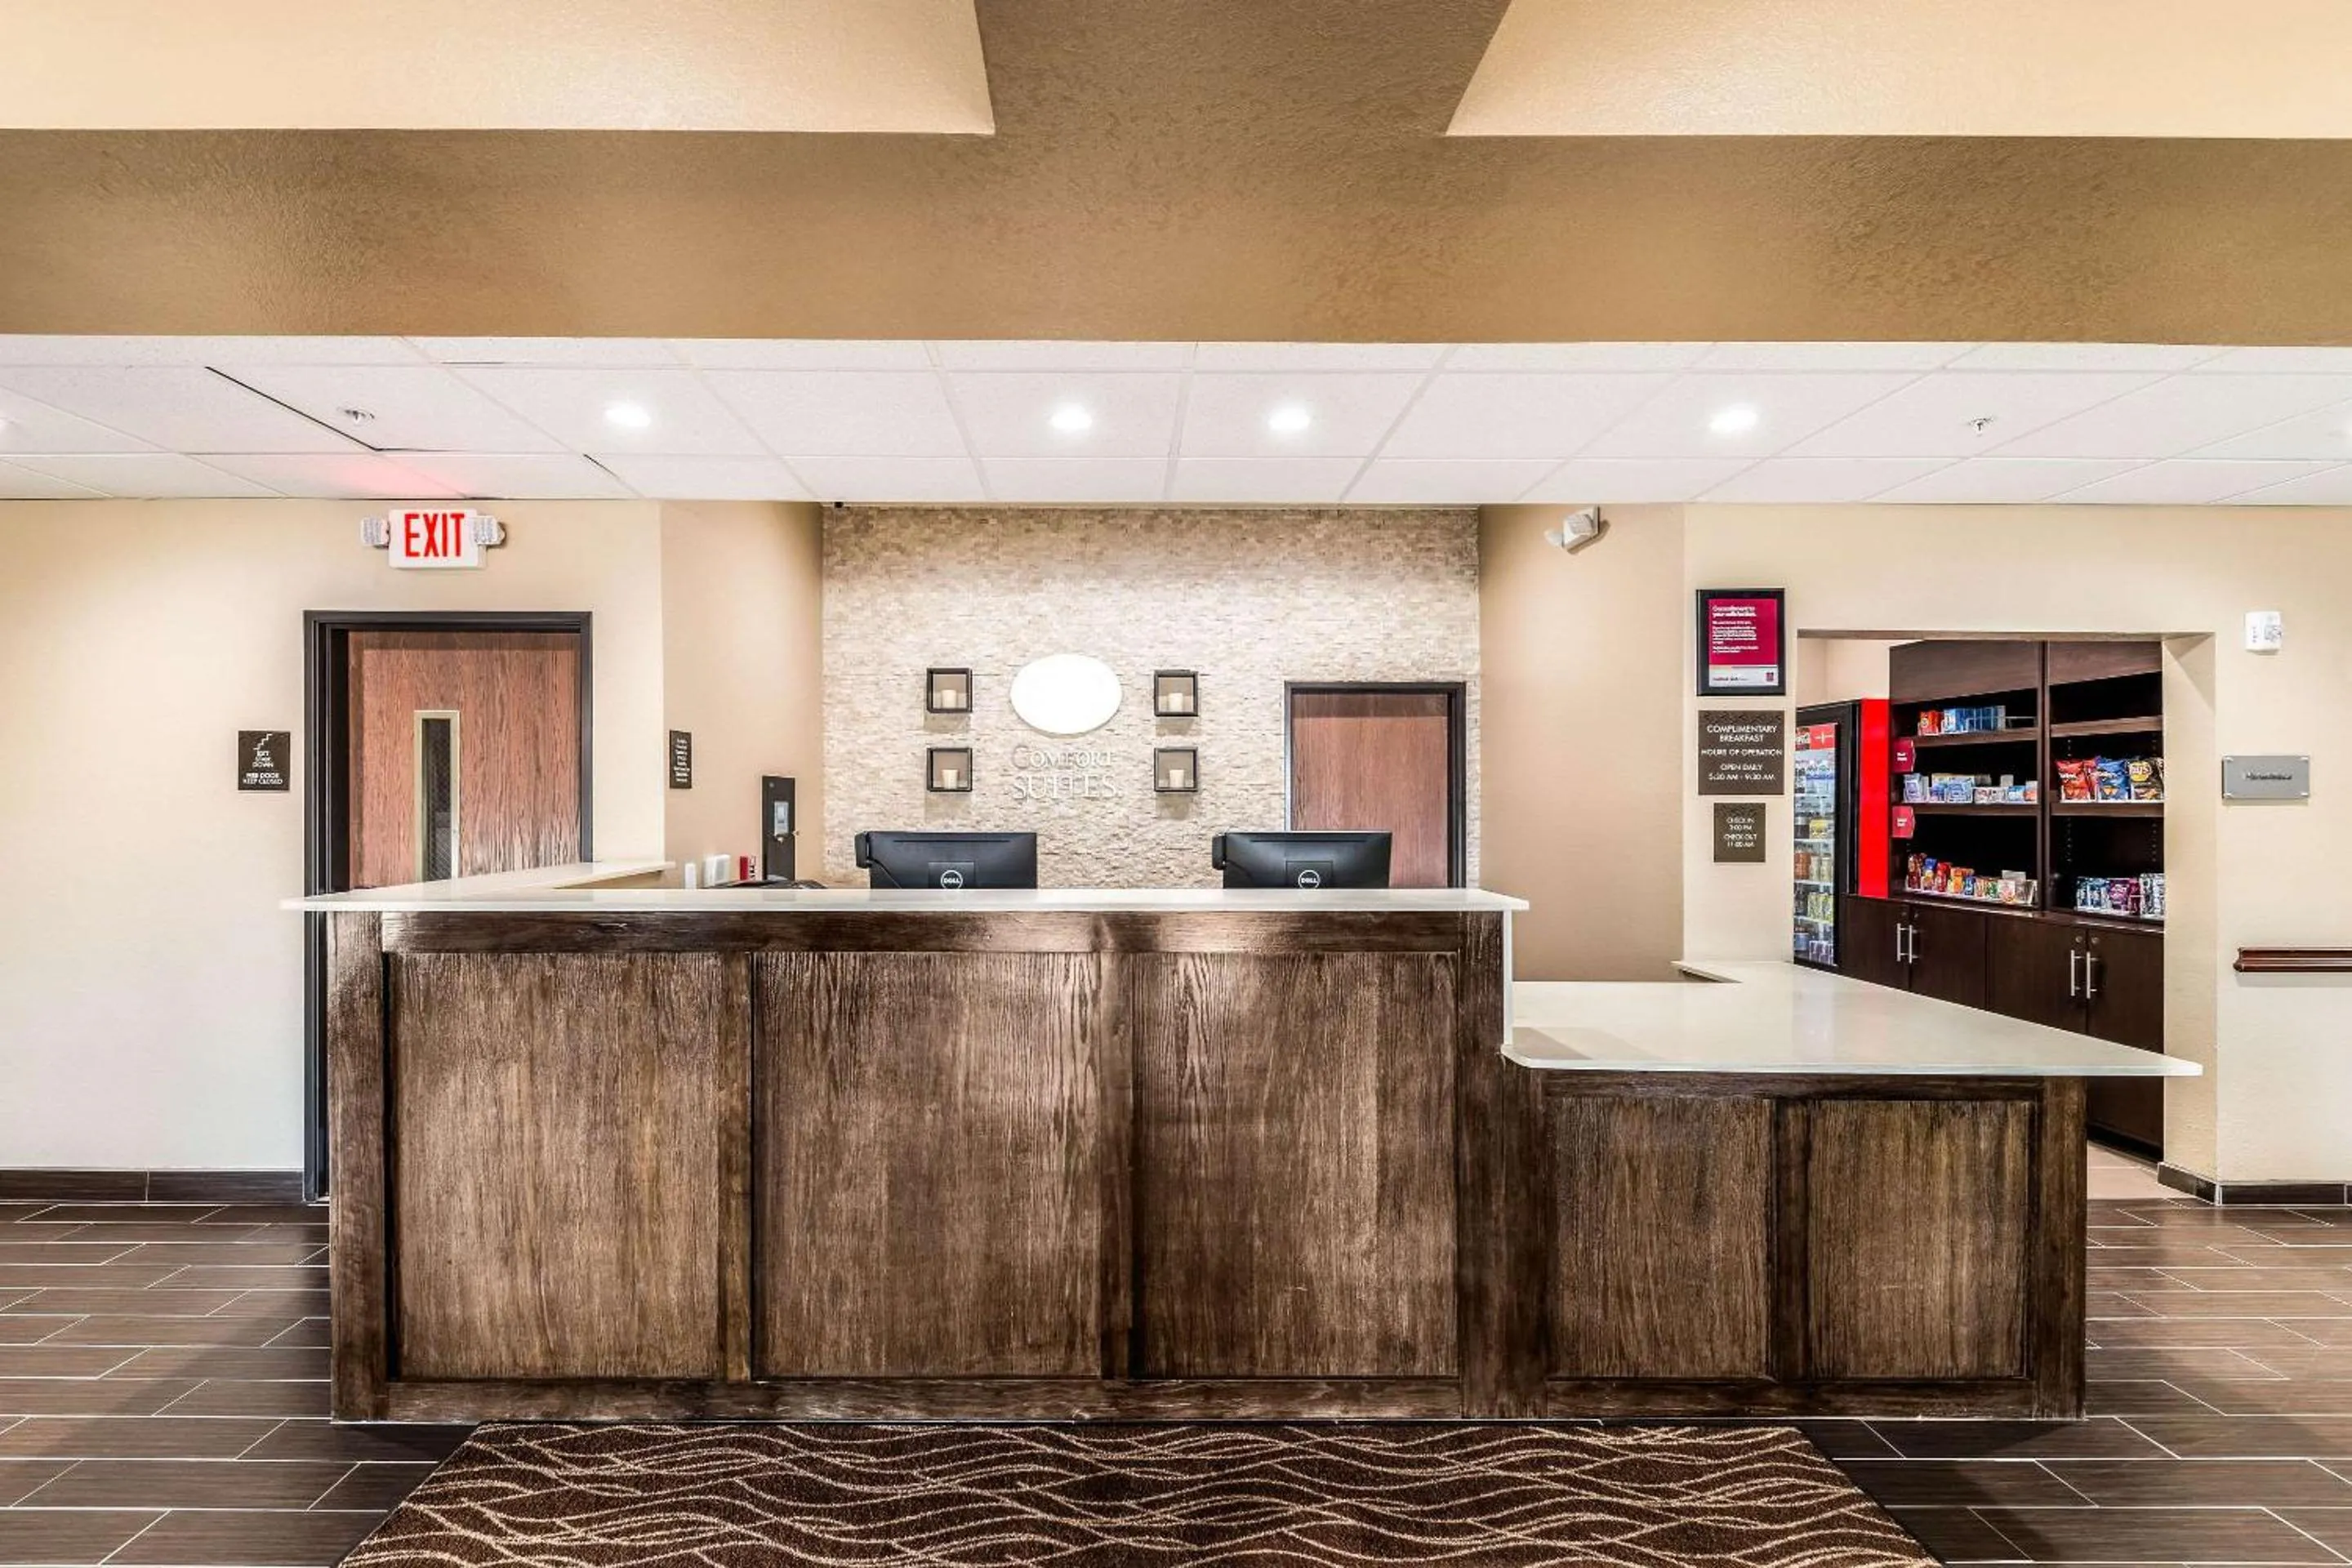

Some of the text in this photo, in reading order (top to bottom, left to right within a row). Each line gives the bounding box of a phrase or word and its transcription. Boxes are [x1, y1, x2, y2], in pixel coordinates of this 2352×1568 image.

[404, 513, 465, 557] EXIT
[1707, 724, 1777, 733] COMPLIMENTARY
[1719, 734, 1764, 742] BREAKFAST
[1013, 773, 1118, 800] SUITES
